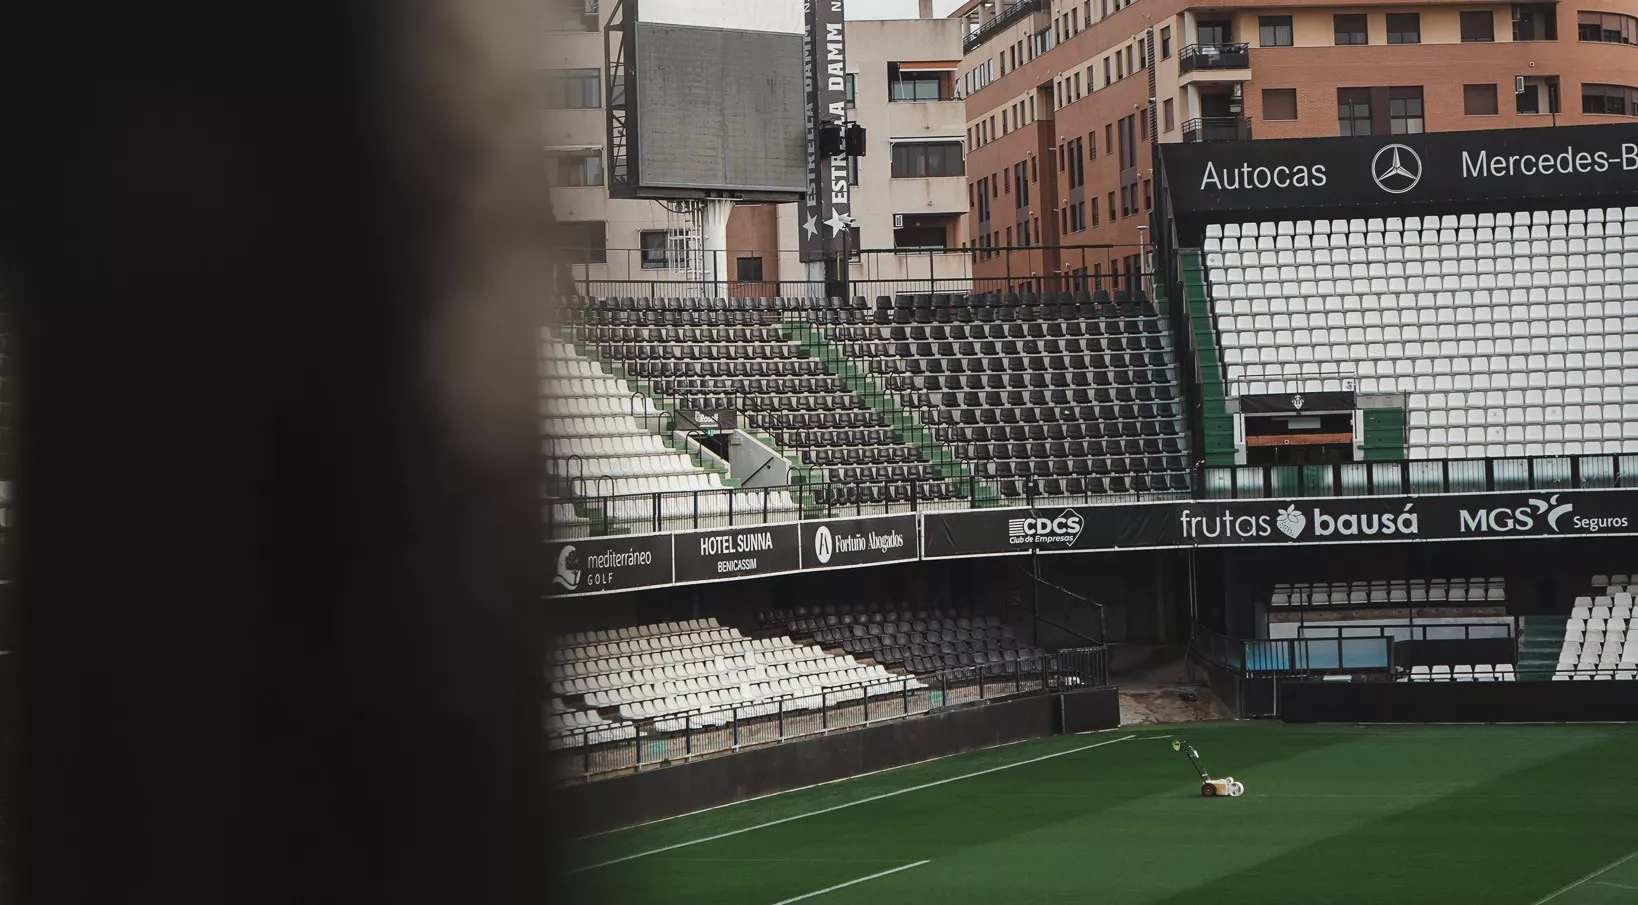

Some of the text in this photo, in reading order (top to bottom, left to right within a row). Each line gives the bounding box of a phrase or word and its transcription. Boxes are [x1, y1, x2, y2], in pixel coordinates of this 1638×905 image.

[826, 22, 845, 91] DAMM
[828, 101, 848, 204] ESTRLA
[1200, 161, 1327, 190] Autocas
[1023, 516, 1081, 535] CDCS
[1180, 503, 1419, 538] frutas bausá
[1459, 506, 1628, 532] MGS Seguros
[700, 531, 773, 556] HOTEL SUNNA
[835, 529, 904, 553] Fortuño Abogados
[1009, 535, 1074, 544] Club de Empresas
[588, 549, 652, 568] mediterráneo
[717, 558, 757, 573] BENICASSIM
[587, 573, 613, 586] GOLF
